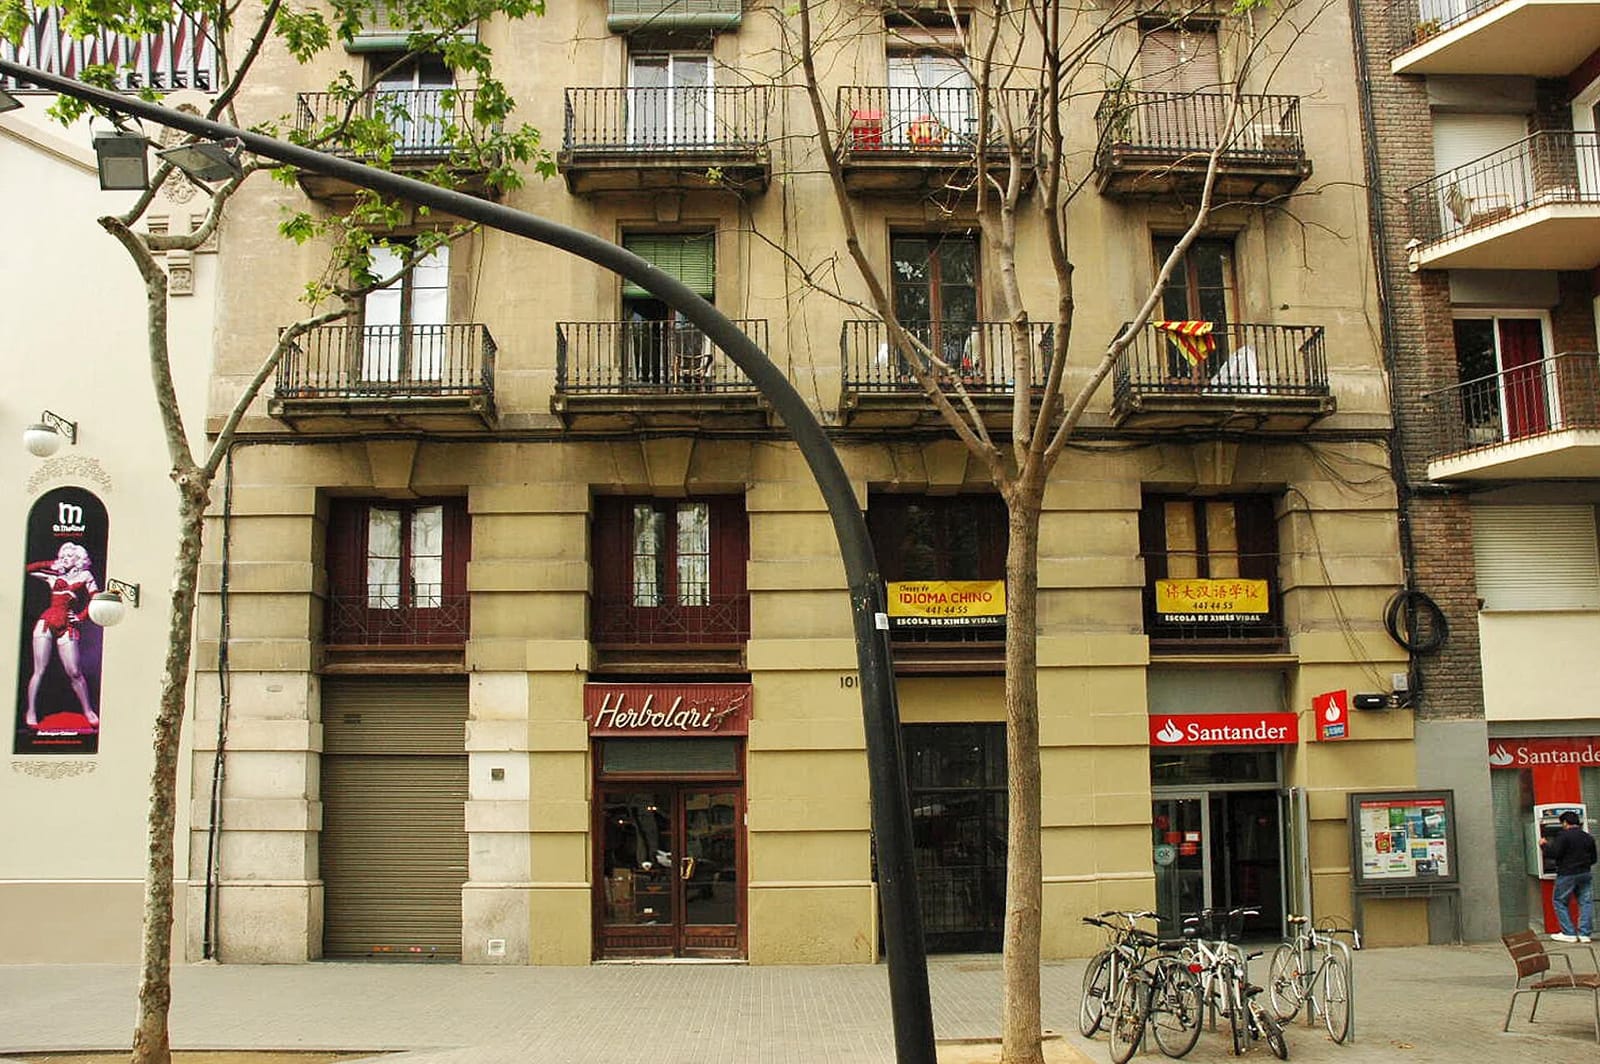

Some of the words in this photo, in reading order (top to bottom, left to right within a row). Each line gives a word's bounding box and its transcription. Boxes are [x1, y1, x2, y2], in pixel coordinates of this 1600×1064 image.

[900, 592, 947, 604] IDIOMA
[950, 592, 992, 603] CHINO
[896, 617, 929, 625] ESCOLA
[970, 616, 998, 624] VIDAL
[1165, 614, 1196, 622] ESCOLA
[1198, 614, 1209, 622] DE
[840, 676, 859, 688] 101
[594, 692, 715, 731] Herbolari
[1187, 720, 1288, 742] Santander
